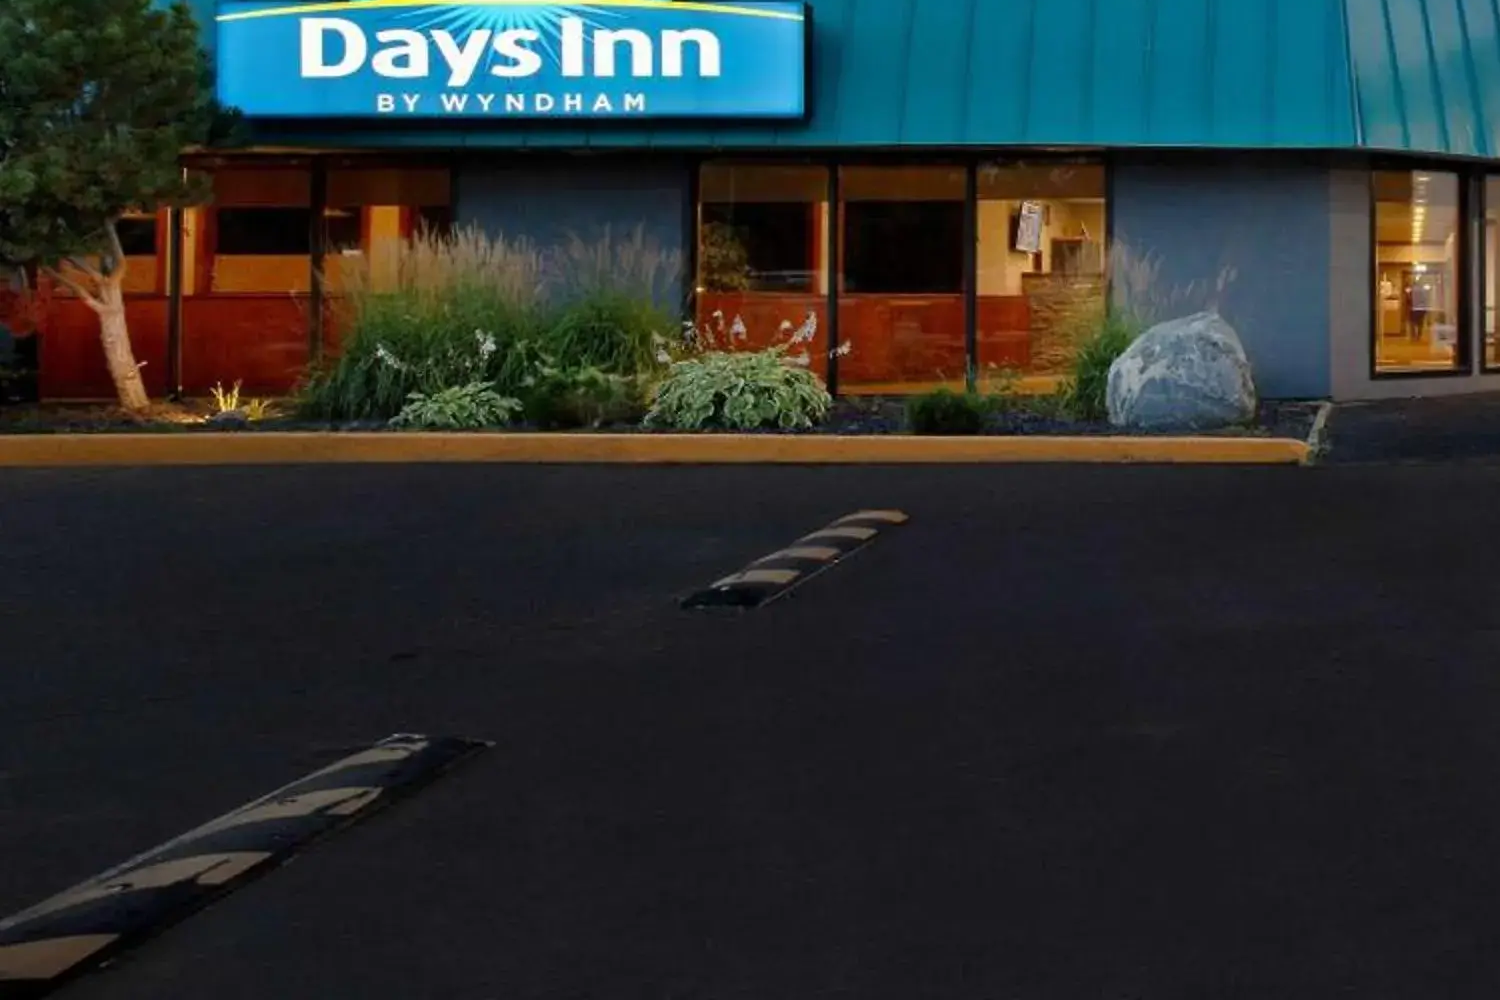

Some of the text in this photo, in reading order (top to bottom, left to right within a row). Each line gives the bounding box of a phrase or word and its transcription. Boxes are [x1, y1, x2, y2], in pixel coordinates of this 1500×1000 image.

[300, 15, 720, 87] Days Inn
[377, 93, 646, 112] BY WYNDHAM
